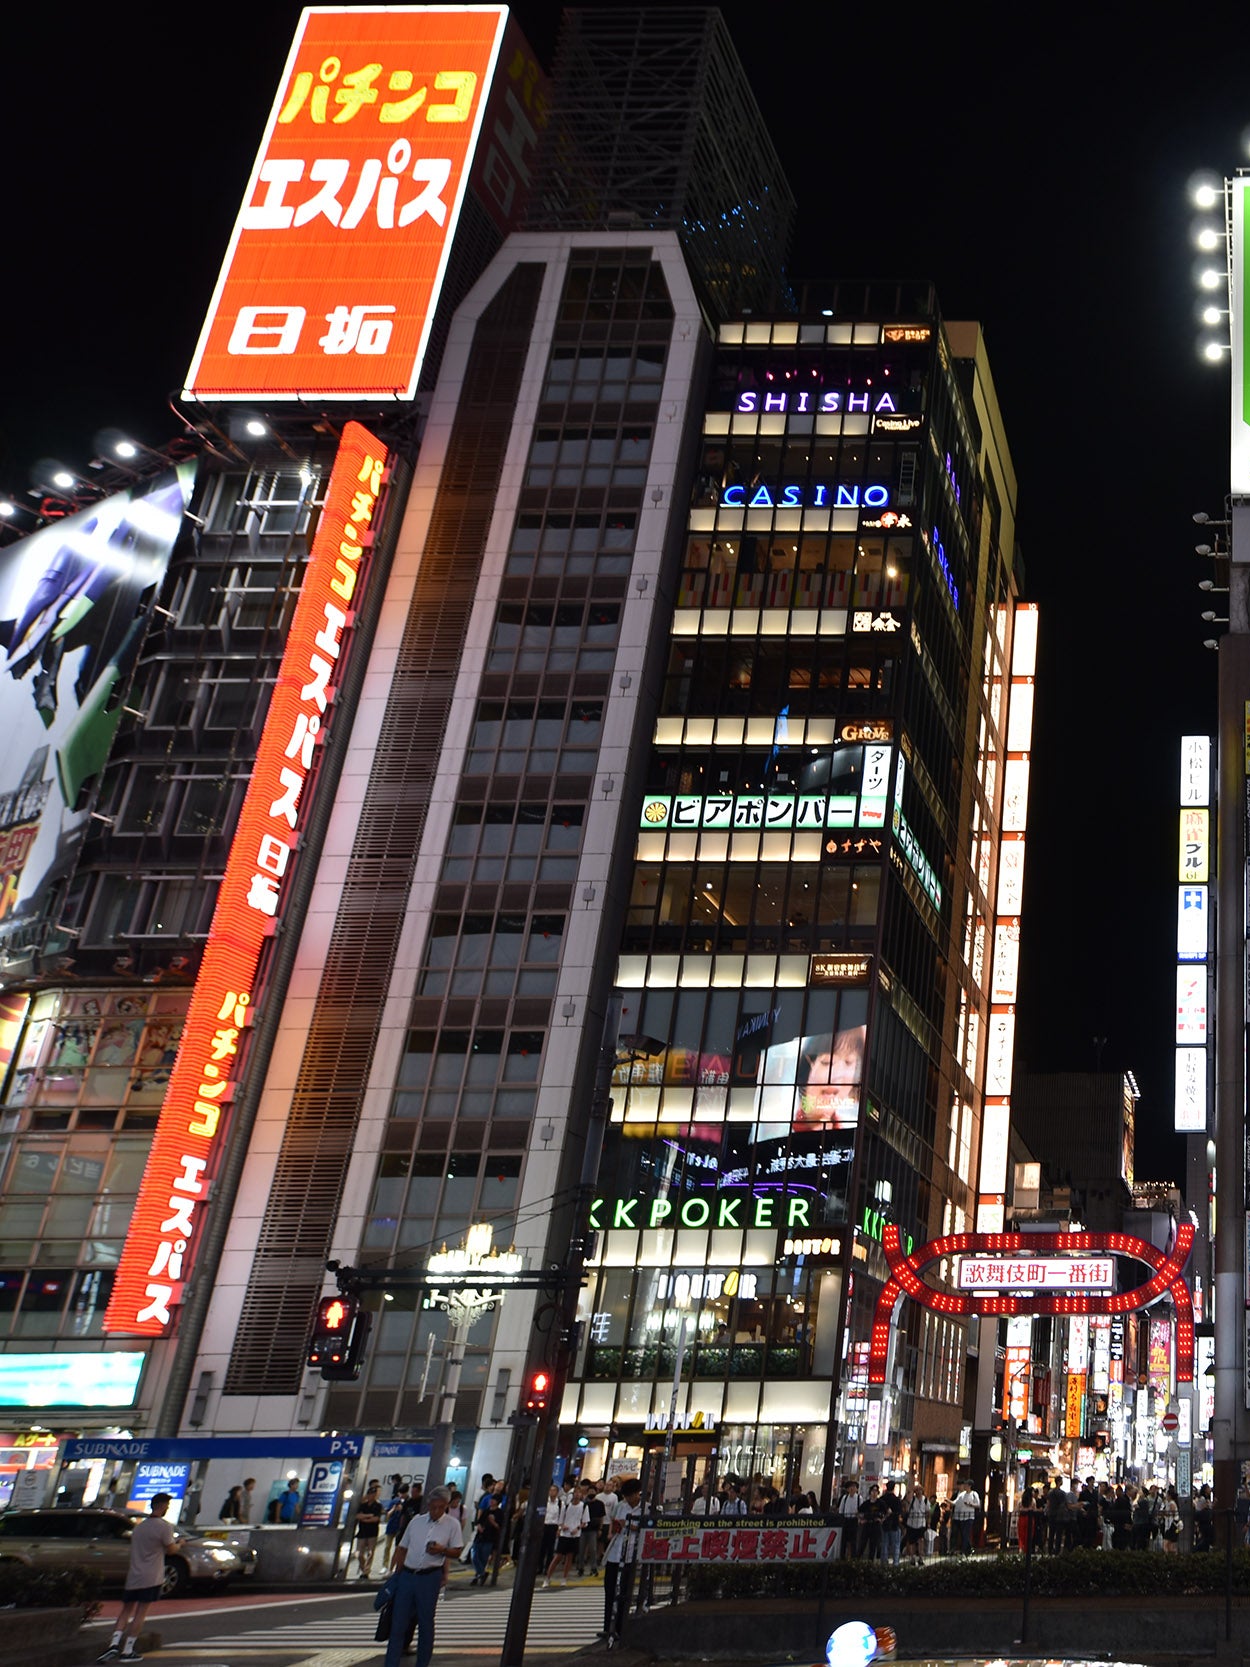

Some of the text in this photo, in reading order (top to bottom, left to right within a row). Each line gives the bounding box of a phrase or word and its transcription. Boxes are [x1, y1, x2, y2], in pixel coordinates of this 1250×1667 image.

[279, 56, 477, 123] パチンコ
[240, 139, 453, 229] エスパス
[227, 305, 397, 355] 日拓
[738, 392, 896, 412] SHISHA
[723, 485, 889, 507] CASINO
[329, 460, 384, 601] パチンコ
[269, 602, 347, 829] エスパス
[841, 725, 889, 742] GROVE
[868, 749, 888, 790] ダーツ
[1187, 741, 1203, 801] 小松ビル
[673, 799, 853, 826] ビアポンバー
[136, 991, 250, 1326] パチンコ エスパス
[965, 1264, 1109, 1284] 歌舞伎町一番街
[74, 1442, 150, 1456] SUBNADE
[330, 1441, 341, 1455] P
[138, 1465, 188, 1478] SUBNADE
[312, 1467, 328, 1490] P
[656, 1518, 701, 1529] Smorking
[718, 1518, 734, 1527] the
[735, 1518, 764, 1528] street
[766, 1518, 775, 1527] is
[777, 1518, 827, 1529] prohibited.
